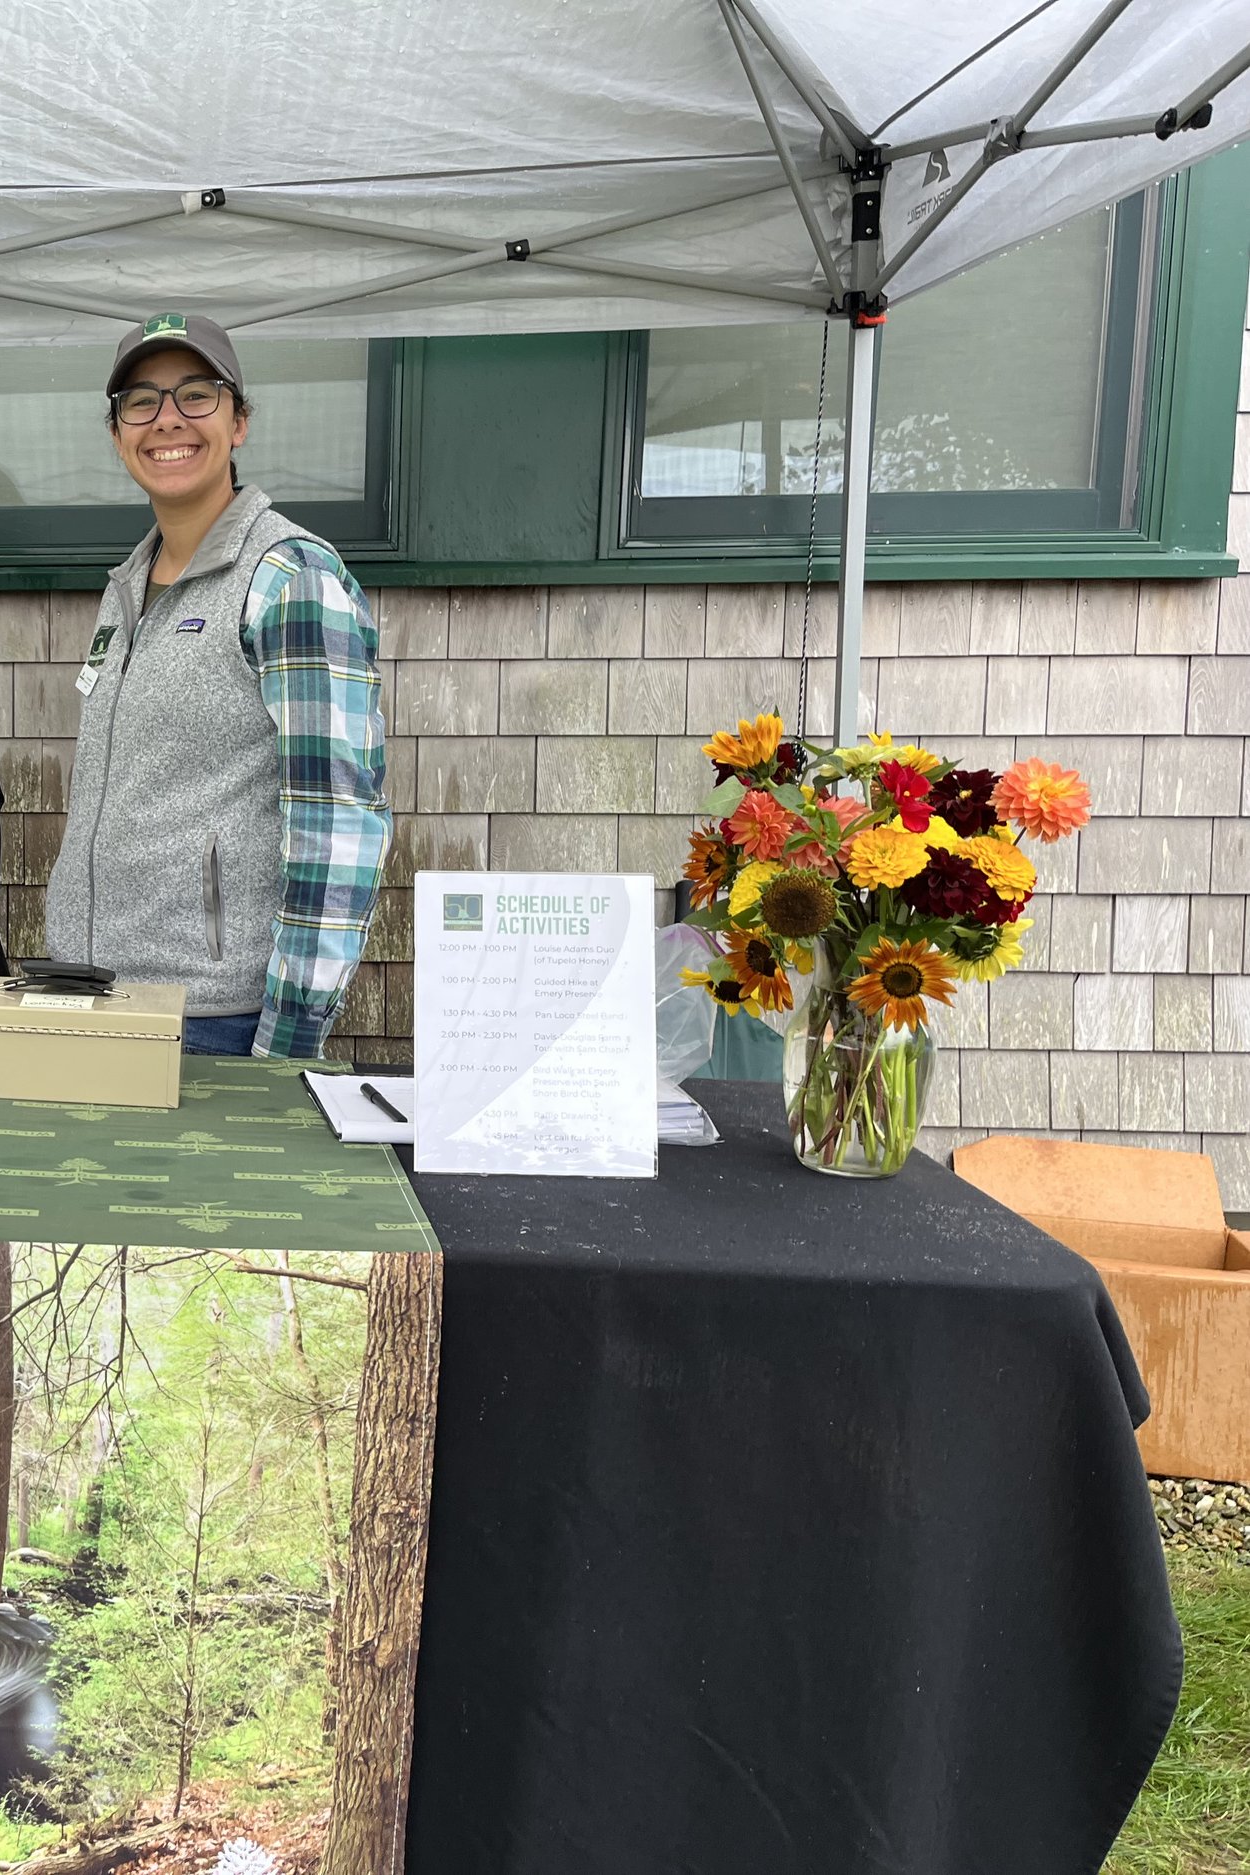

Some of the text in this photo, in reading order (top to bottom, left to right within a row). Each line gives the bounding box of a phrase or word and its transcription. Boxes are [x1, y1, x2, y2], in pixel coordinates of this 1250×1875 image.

[445, 895, 482, 919] 50
[496, 895, 611, 915] SCHEDULE OF
[497, 916, 590, 936] ACTIVITIES
[462, 944, 477, 952] PM
[503, 944, 517, 952] PM
[534, 945, 615, 954] Louise Adams Duo
[534, 956, 610, 966] (of Tupelo Honey)
[460, 977, 475, 985] PM
[503, 977, 517, 985] PM
[534, 978, 565, 986] Guided
[568, 978, 588, 986] Hike
[534, 990, 603, 999] Emery Preserve
[461, 1010, 475, 1018] PM
[503, 1010, 517, 1018] PM
[461, 1031, 476, 1039] PM
[503, 1031, 517, 1039] PM
[534, 1033, 596, 1043] Davis-Douglas
[555, 1045, 574, 1053] with
[576, 1045, 596, 1053] Sam
[461, 1064, 475, 1072] PM
[503, 1064, 517, 1072] PM
[533, 1066, 551, 1074] Bird
[576, 1067, 586, 1075] at
[532, 1079, 569, 1087] Preserve
[532, 1090, 601, 1098] Shore Bird Club
[504, 1110, 518, 1118] PM
[561, 1112, 598, 1121] Drawing
[554, 1134, 568, 1142] call
[119, 1142, 217, 1150] WILDLANDS
[184, 1208, 297, 1218] WILDLANDS
